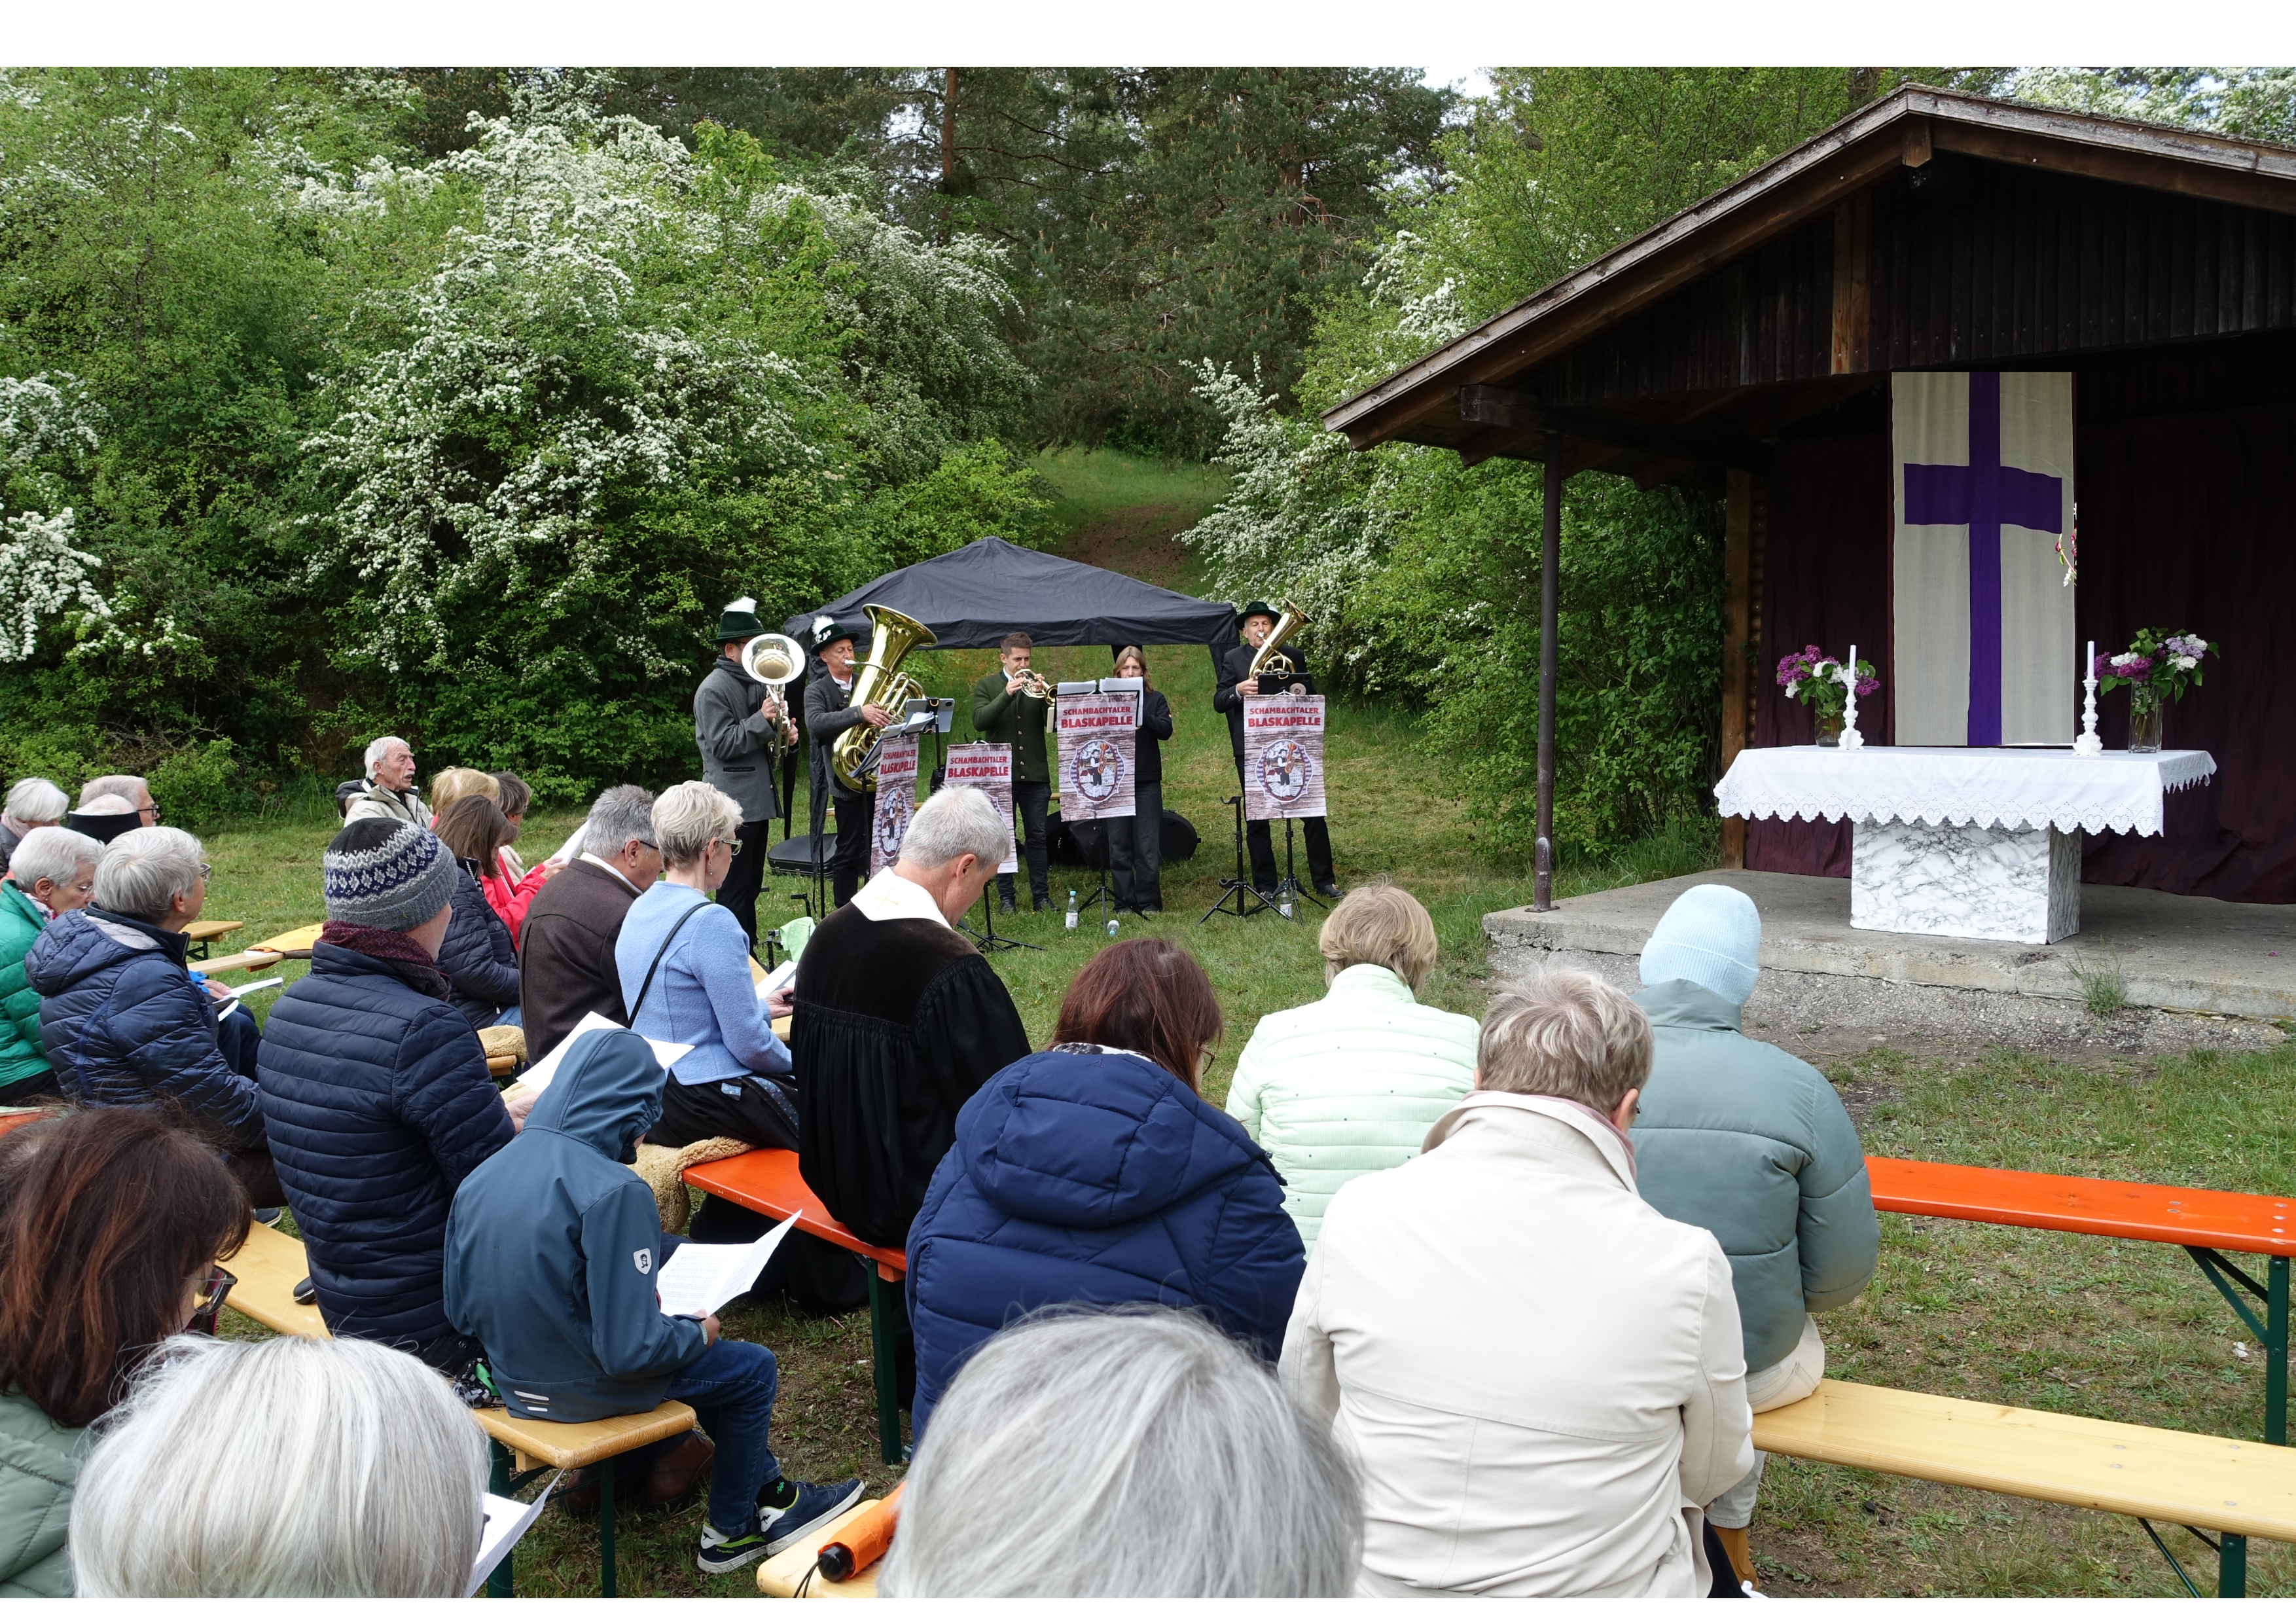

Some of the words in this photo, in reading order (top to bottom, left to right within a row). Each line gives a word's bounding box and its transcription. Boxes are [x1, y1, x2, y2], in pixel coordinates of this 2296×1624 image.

[1063, 706, 1130, 715] SCHAMBACHTALER
[1061, 716, 1132, 728] BLASKAPELLE
[1248, 717, 1321, 727] BLASKAPELLE
[948, 767, 1009, 777] BLASKAPELLE
